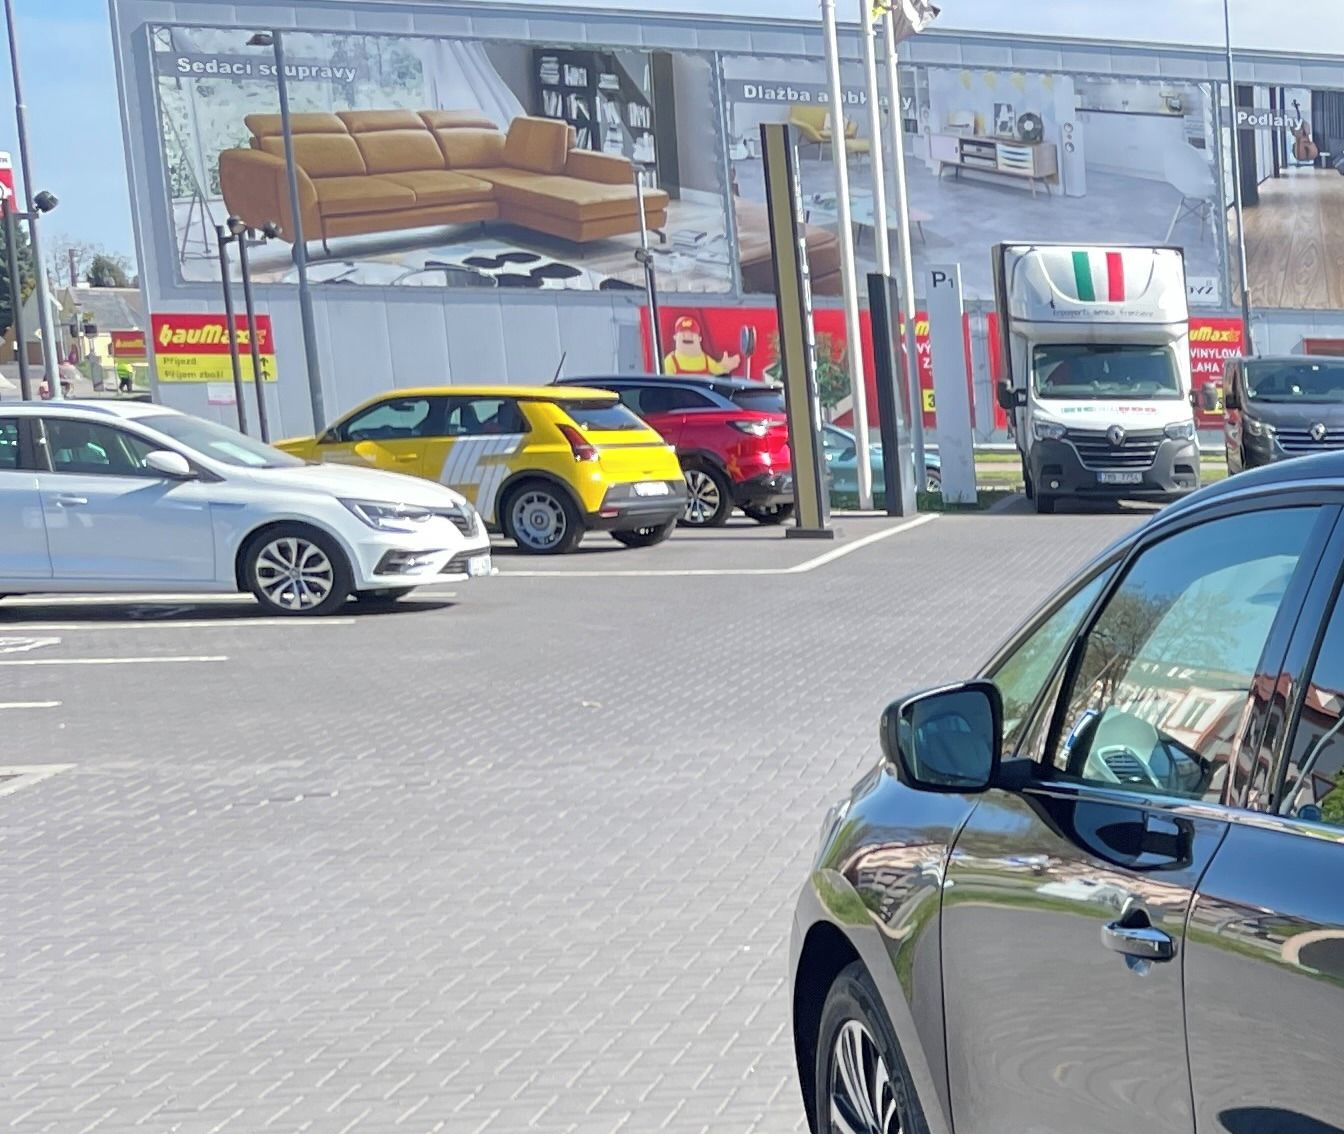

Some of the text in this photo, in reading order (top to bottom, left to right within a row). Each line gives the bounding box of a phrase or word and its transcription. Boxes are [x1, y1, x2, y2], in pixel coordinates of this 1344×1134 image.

[818, 92, 829, 103] a
[840, 91, 912, 110] bkay
[1237, 111, 1303, 131] Podlahy
